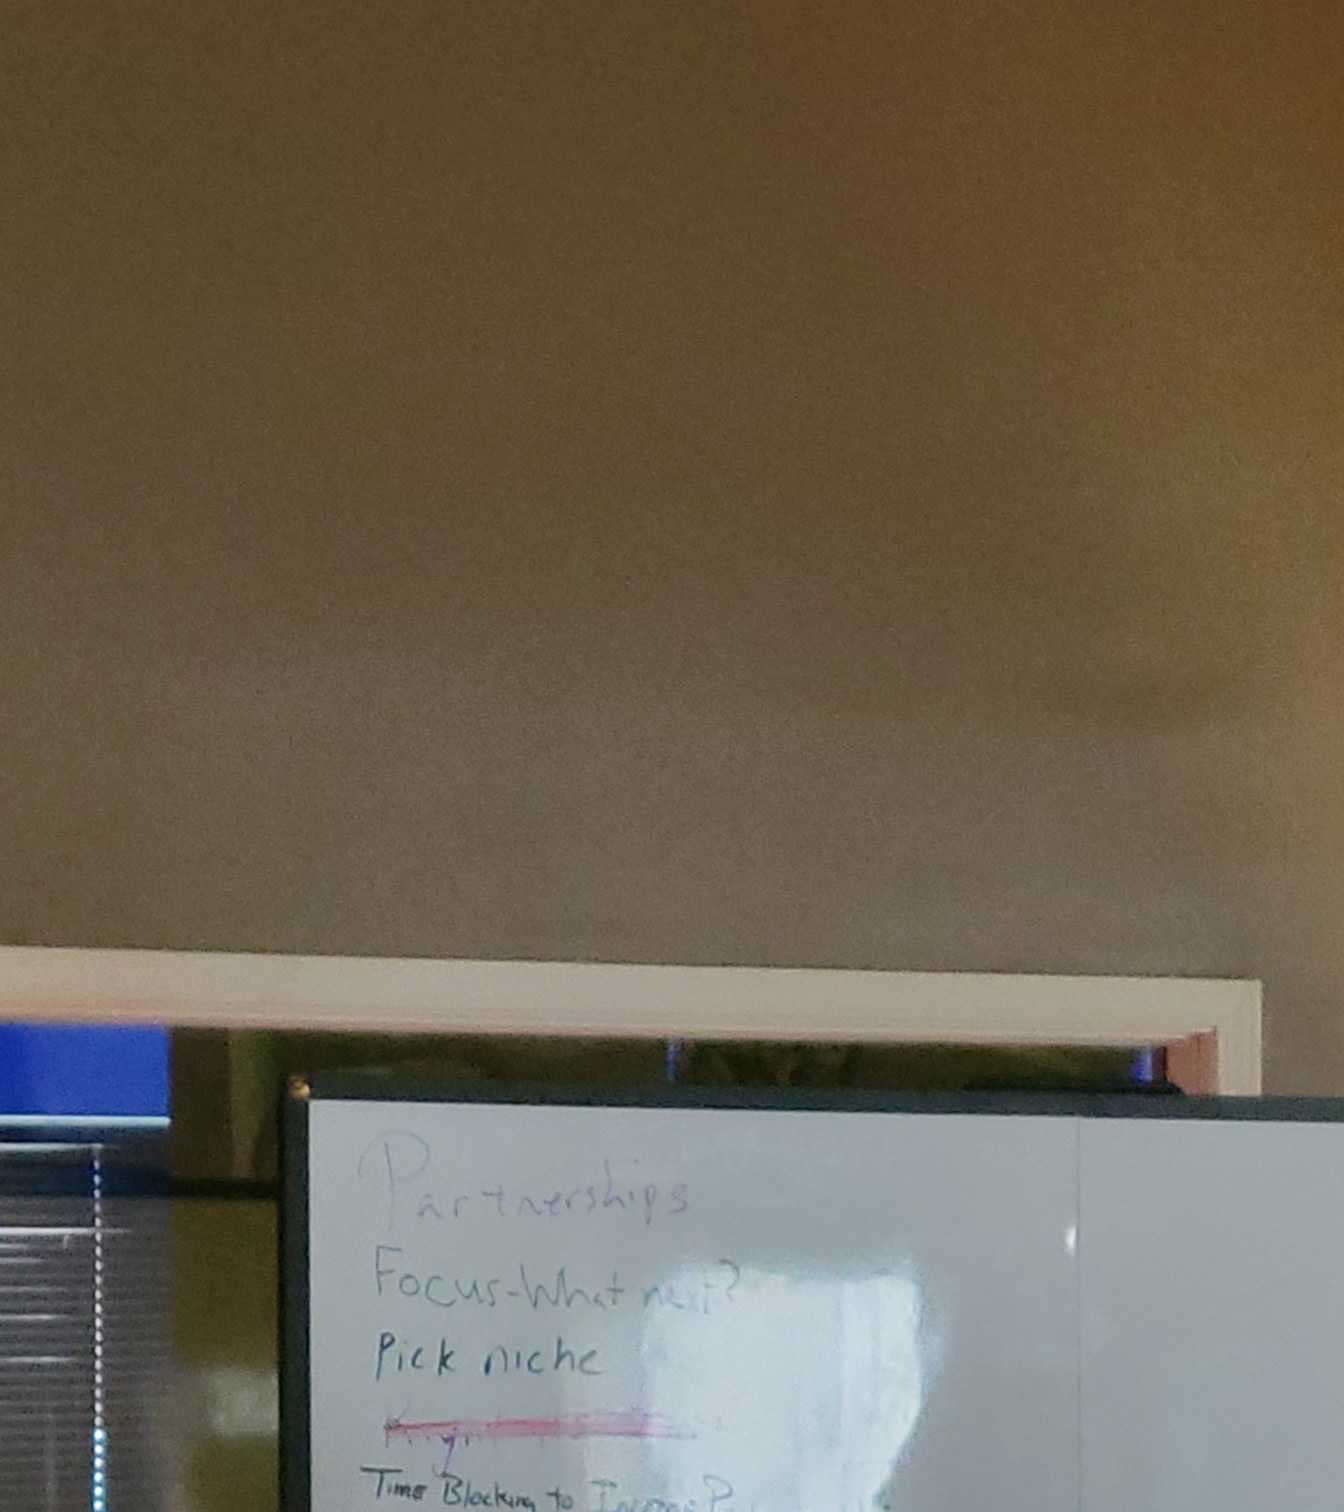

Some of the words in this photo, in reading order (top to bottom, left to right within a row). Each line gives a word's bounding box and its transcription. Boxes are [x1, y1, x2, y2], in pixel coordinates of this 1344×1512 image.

[358, 1132, 690, 1230] Partnerships
[374, 1331, 453, 1380] Pick
[483, 1338, 604, 1377] niche
[546, 1486, 574, 1511] to
